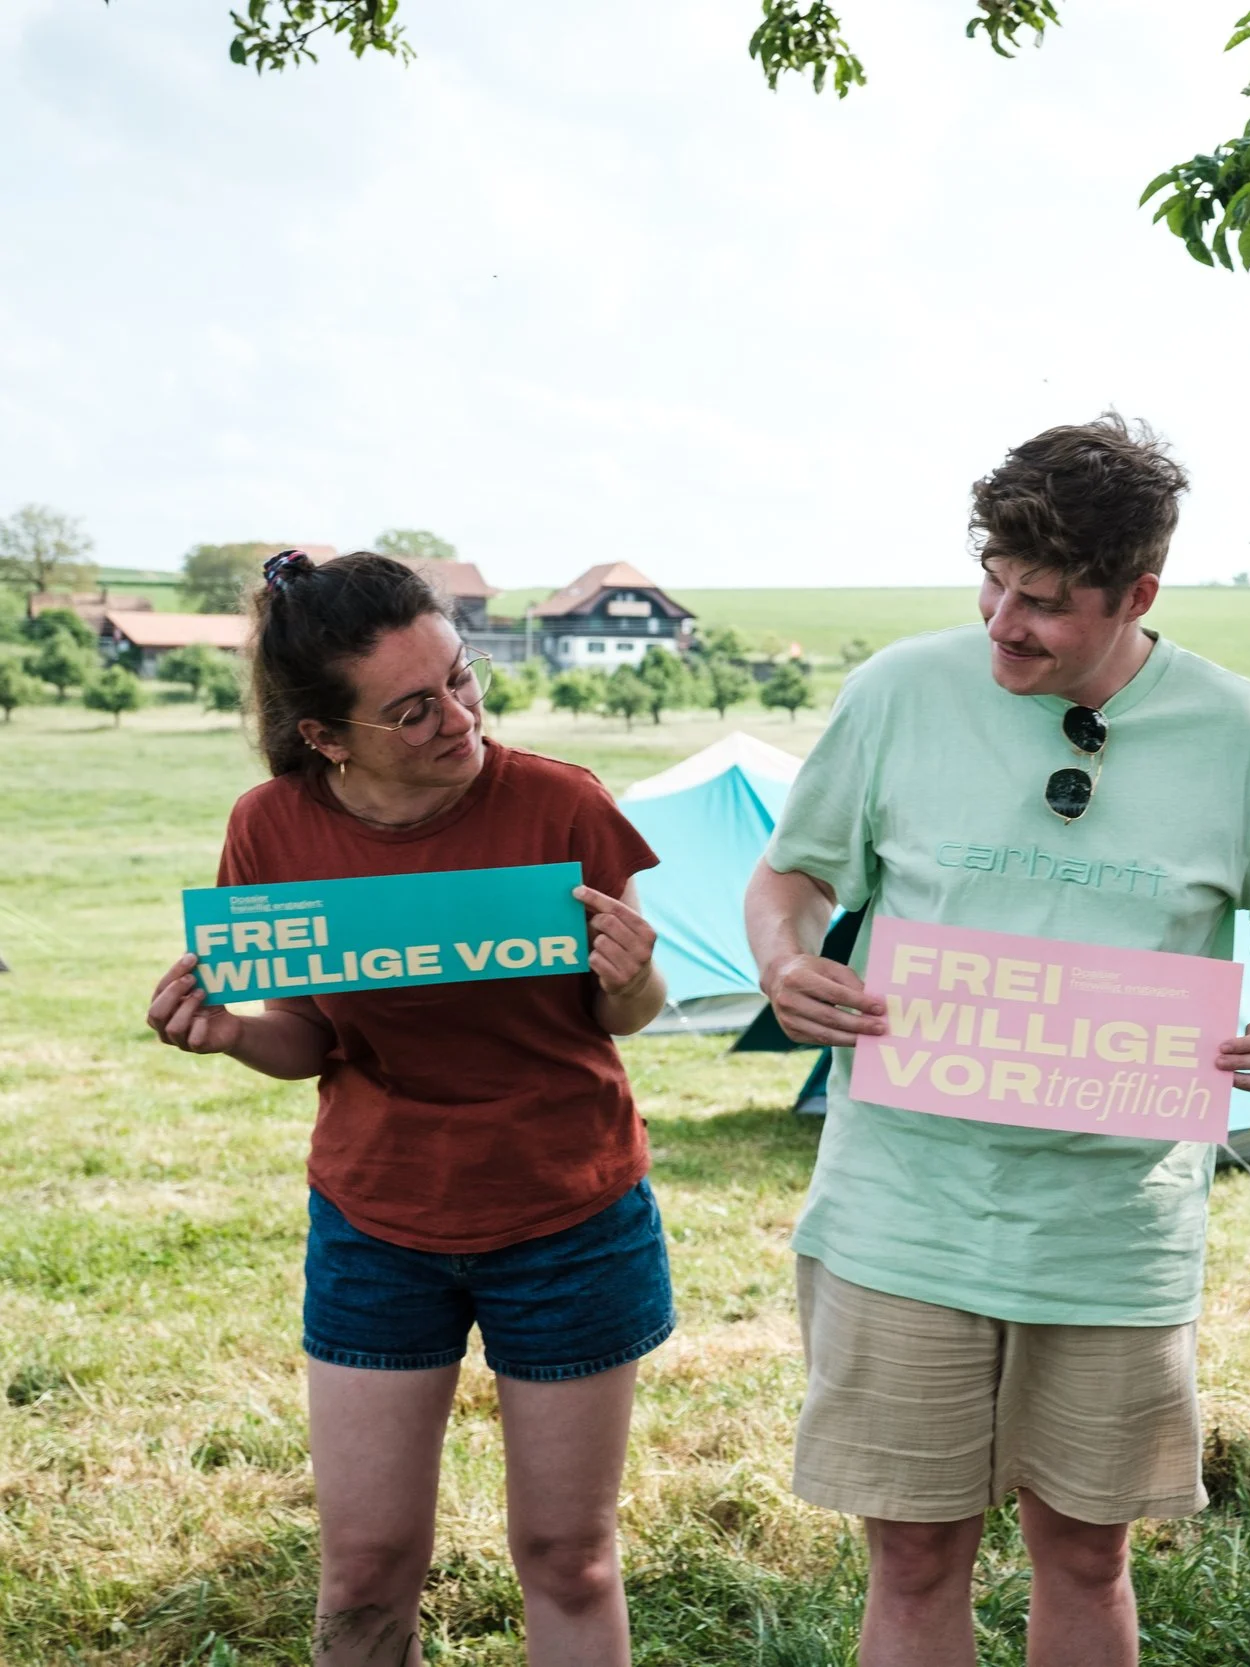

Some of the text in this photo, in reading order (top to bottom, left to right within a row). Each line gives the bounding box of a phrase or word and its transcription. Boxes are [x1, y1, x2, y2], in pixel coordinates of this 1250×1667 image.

[936, 840, 1169, 897] carhartt
[195, 916, 328, 957] FREI
[198, 935, 579, 994] WILLIGE VOR
[891, 943, 1064, 1005] FREI
[885, 994, 1201, 1068] WILLIGE
